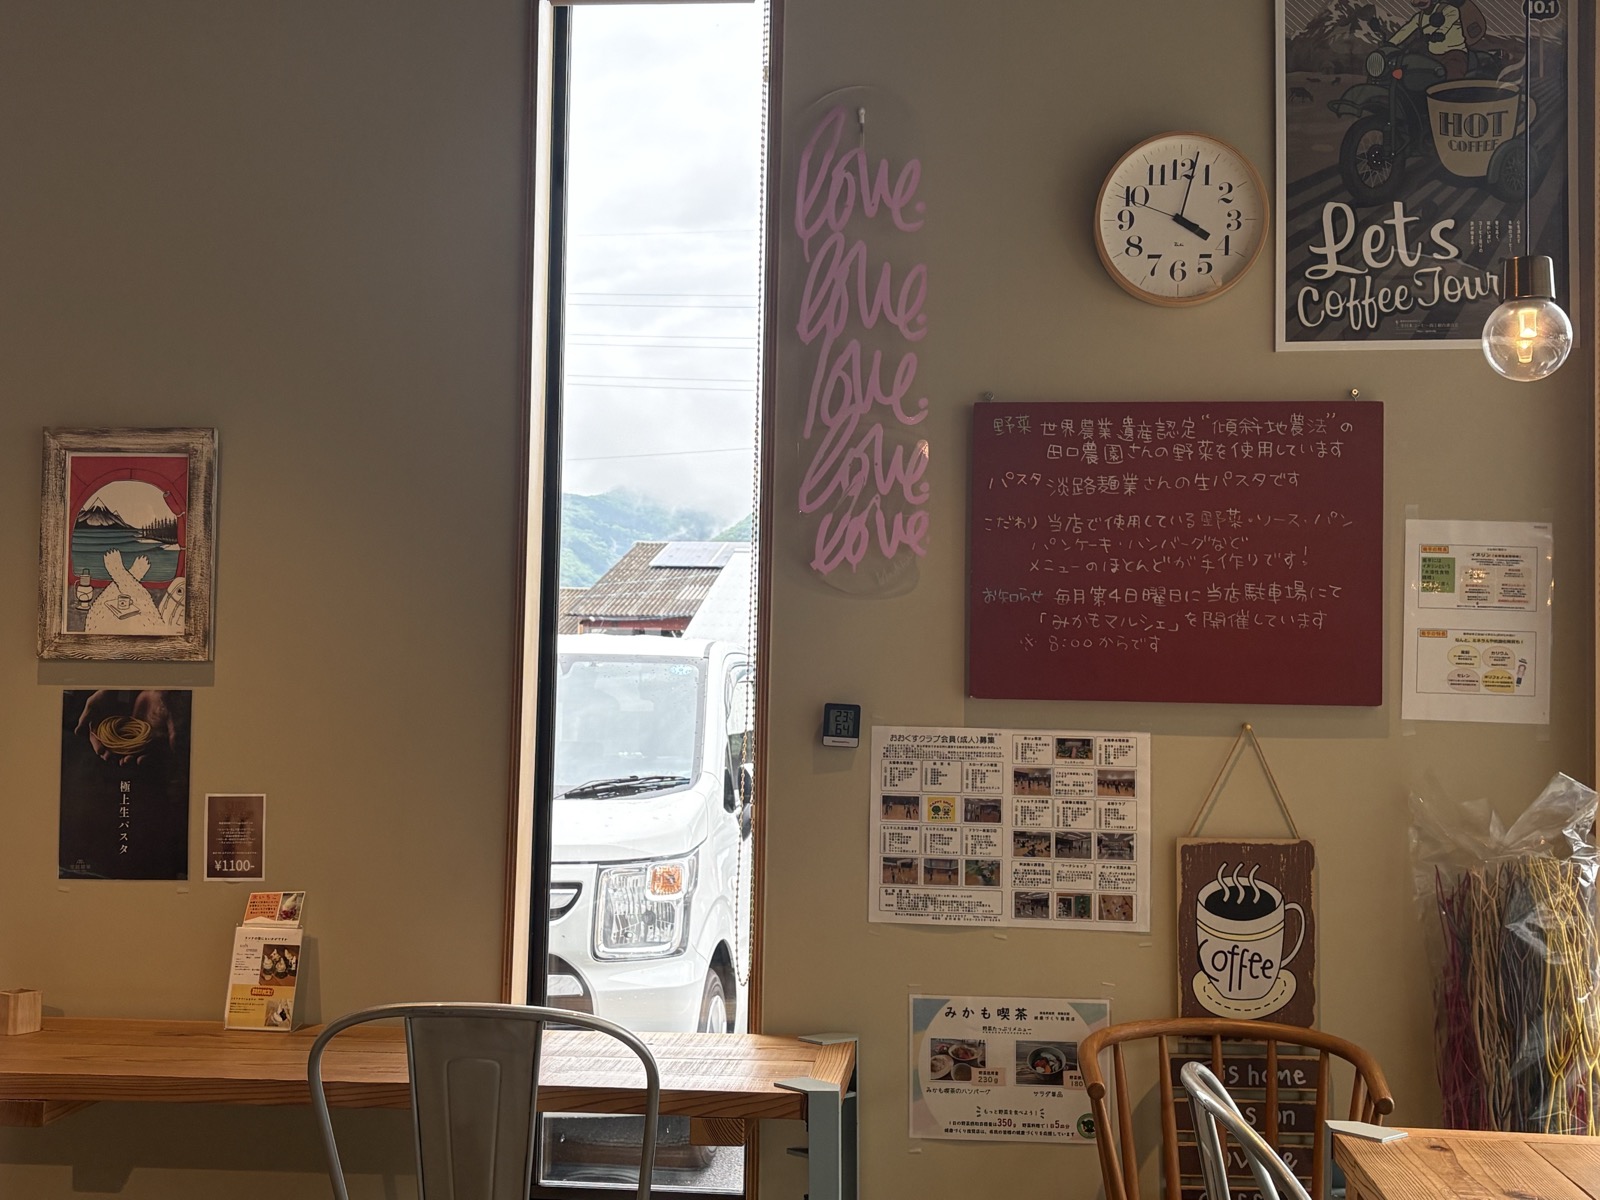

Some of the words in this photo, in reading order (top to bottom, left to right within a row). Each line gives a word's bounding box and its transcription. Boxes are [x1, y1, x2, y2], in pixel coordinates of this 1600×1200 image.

[1439, 110, 1509, 139] HOT
[1448, 139, 1499, 153] COFFEE
[1147, 164, 1168, 186] 11
[1170, 158, 1195, 181] 12
[1202, 164, 1212, 186] 1
[1123, 185, 1150, 208] 10
[1218, 182, 1235, 204] 2
[1117, 209, 1135, 231] 9
[1226, 209, 1242, 231] 3
[1124, 235, 1143, 257] 8
[1215, 234, 1233, 256] 4
[1147, 254, 1162, 277] 7
[1169, 260, 1187, 282] 6
[1197, 253, 1213, 275] 5
[1297, 275, 1415, 331] Coffee
[1414, 266, 1500, 307] Tour
[993, 415, 1033, 436] 野菜
[1046, 441, 1344, 466] 田口農園さんの野菜を使用しています
[988, 472, 1042, 491] パスタ
[984, 514, 1038, 533] こだわり
[982, 586, 1044, 606] お知らせ
[835, 723, 850, 735] 64
[119, 780, 131, 854] 極上生パスタ
[214, 859, 256, 873] ¥1100-
[1197, 938, 1274, 993] Coffee
[944, 1007, 1029, 1021] みかも喫茶
